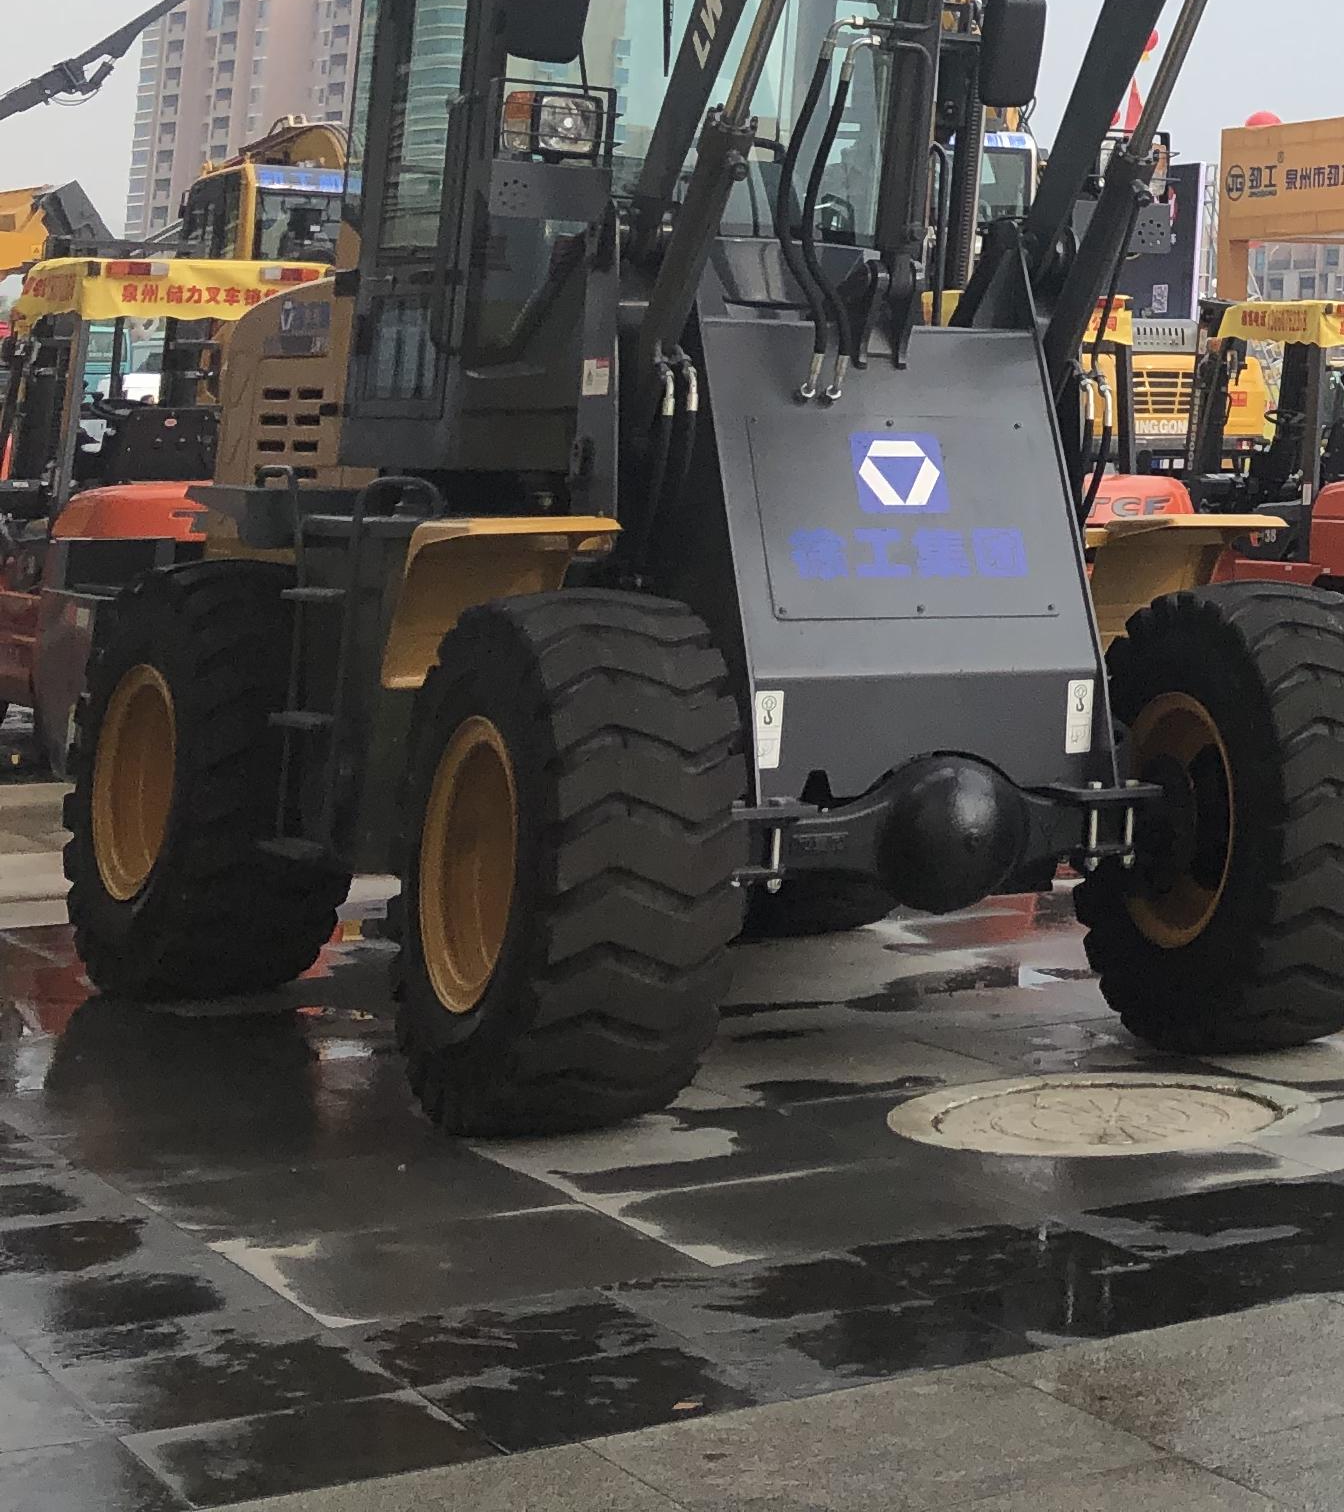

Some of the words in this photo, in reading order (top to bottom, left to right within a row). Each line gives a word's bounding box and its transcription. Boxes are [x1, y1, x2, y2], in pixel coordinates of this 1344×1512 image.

[1249, 165, 1277, 189] 劲工
[789, 527, 1029, 581] 徐工集团
